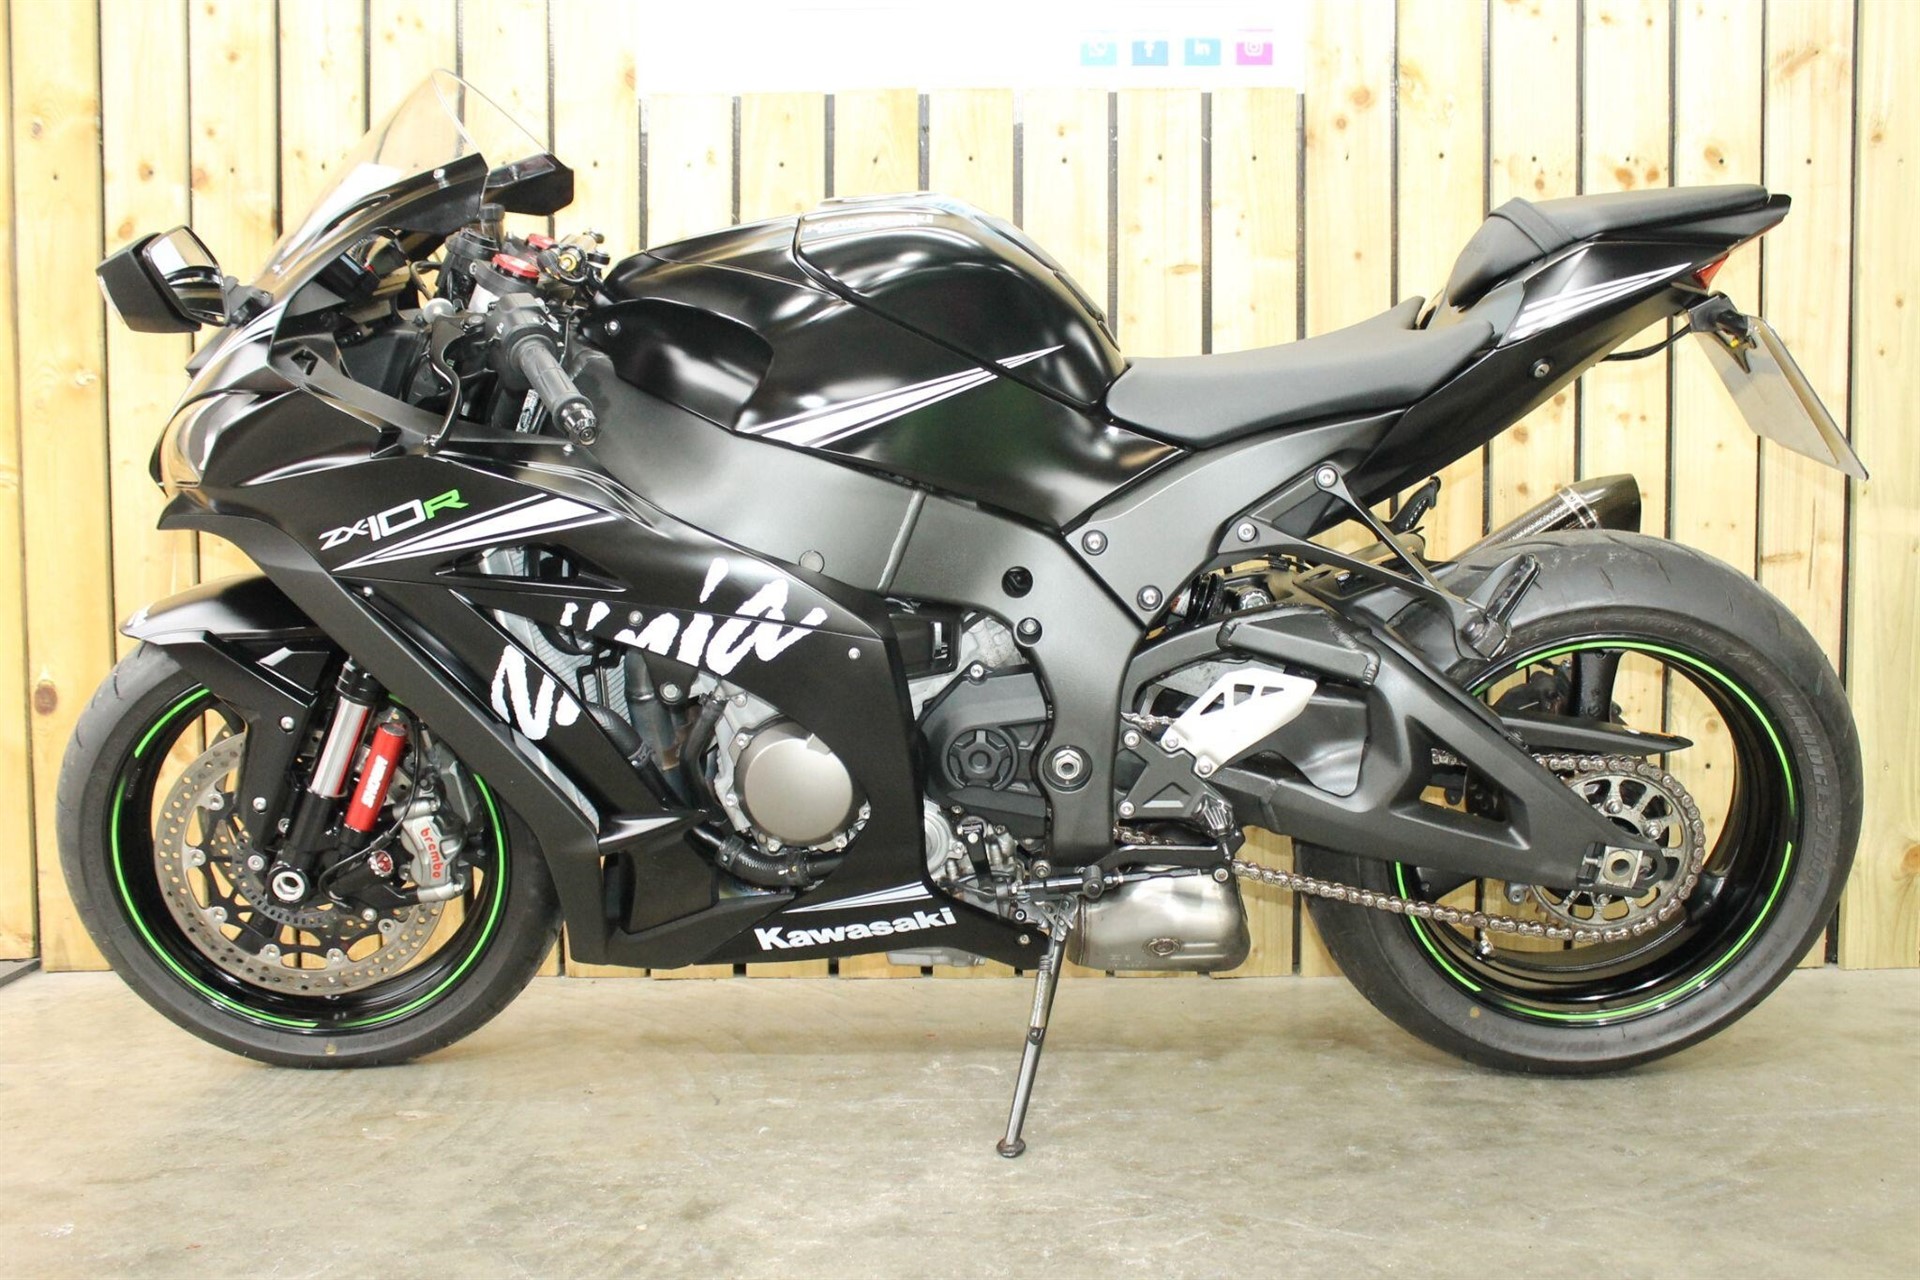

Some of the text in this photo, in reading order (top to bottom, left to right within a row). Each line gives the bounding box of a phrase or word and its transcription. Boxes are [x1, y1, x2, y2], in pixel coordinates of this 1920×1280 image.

[318, 489, 469, 550] ZX-10R
[420, 827, 444, 879] brembo
[754, 907, 957, 951] Kawasaki
